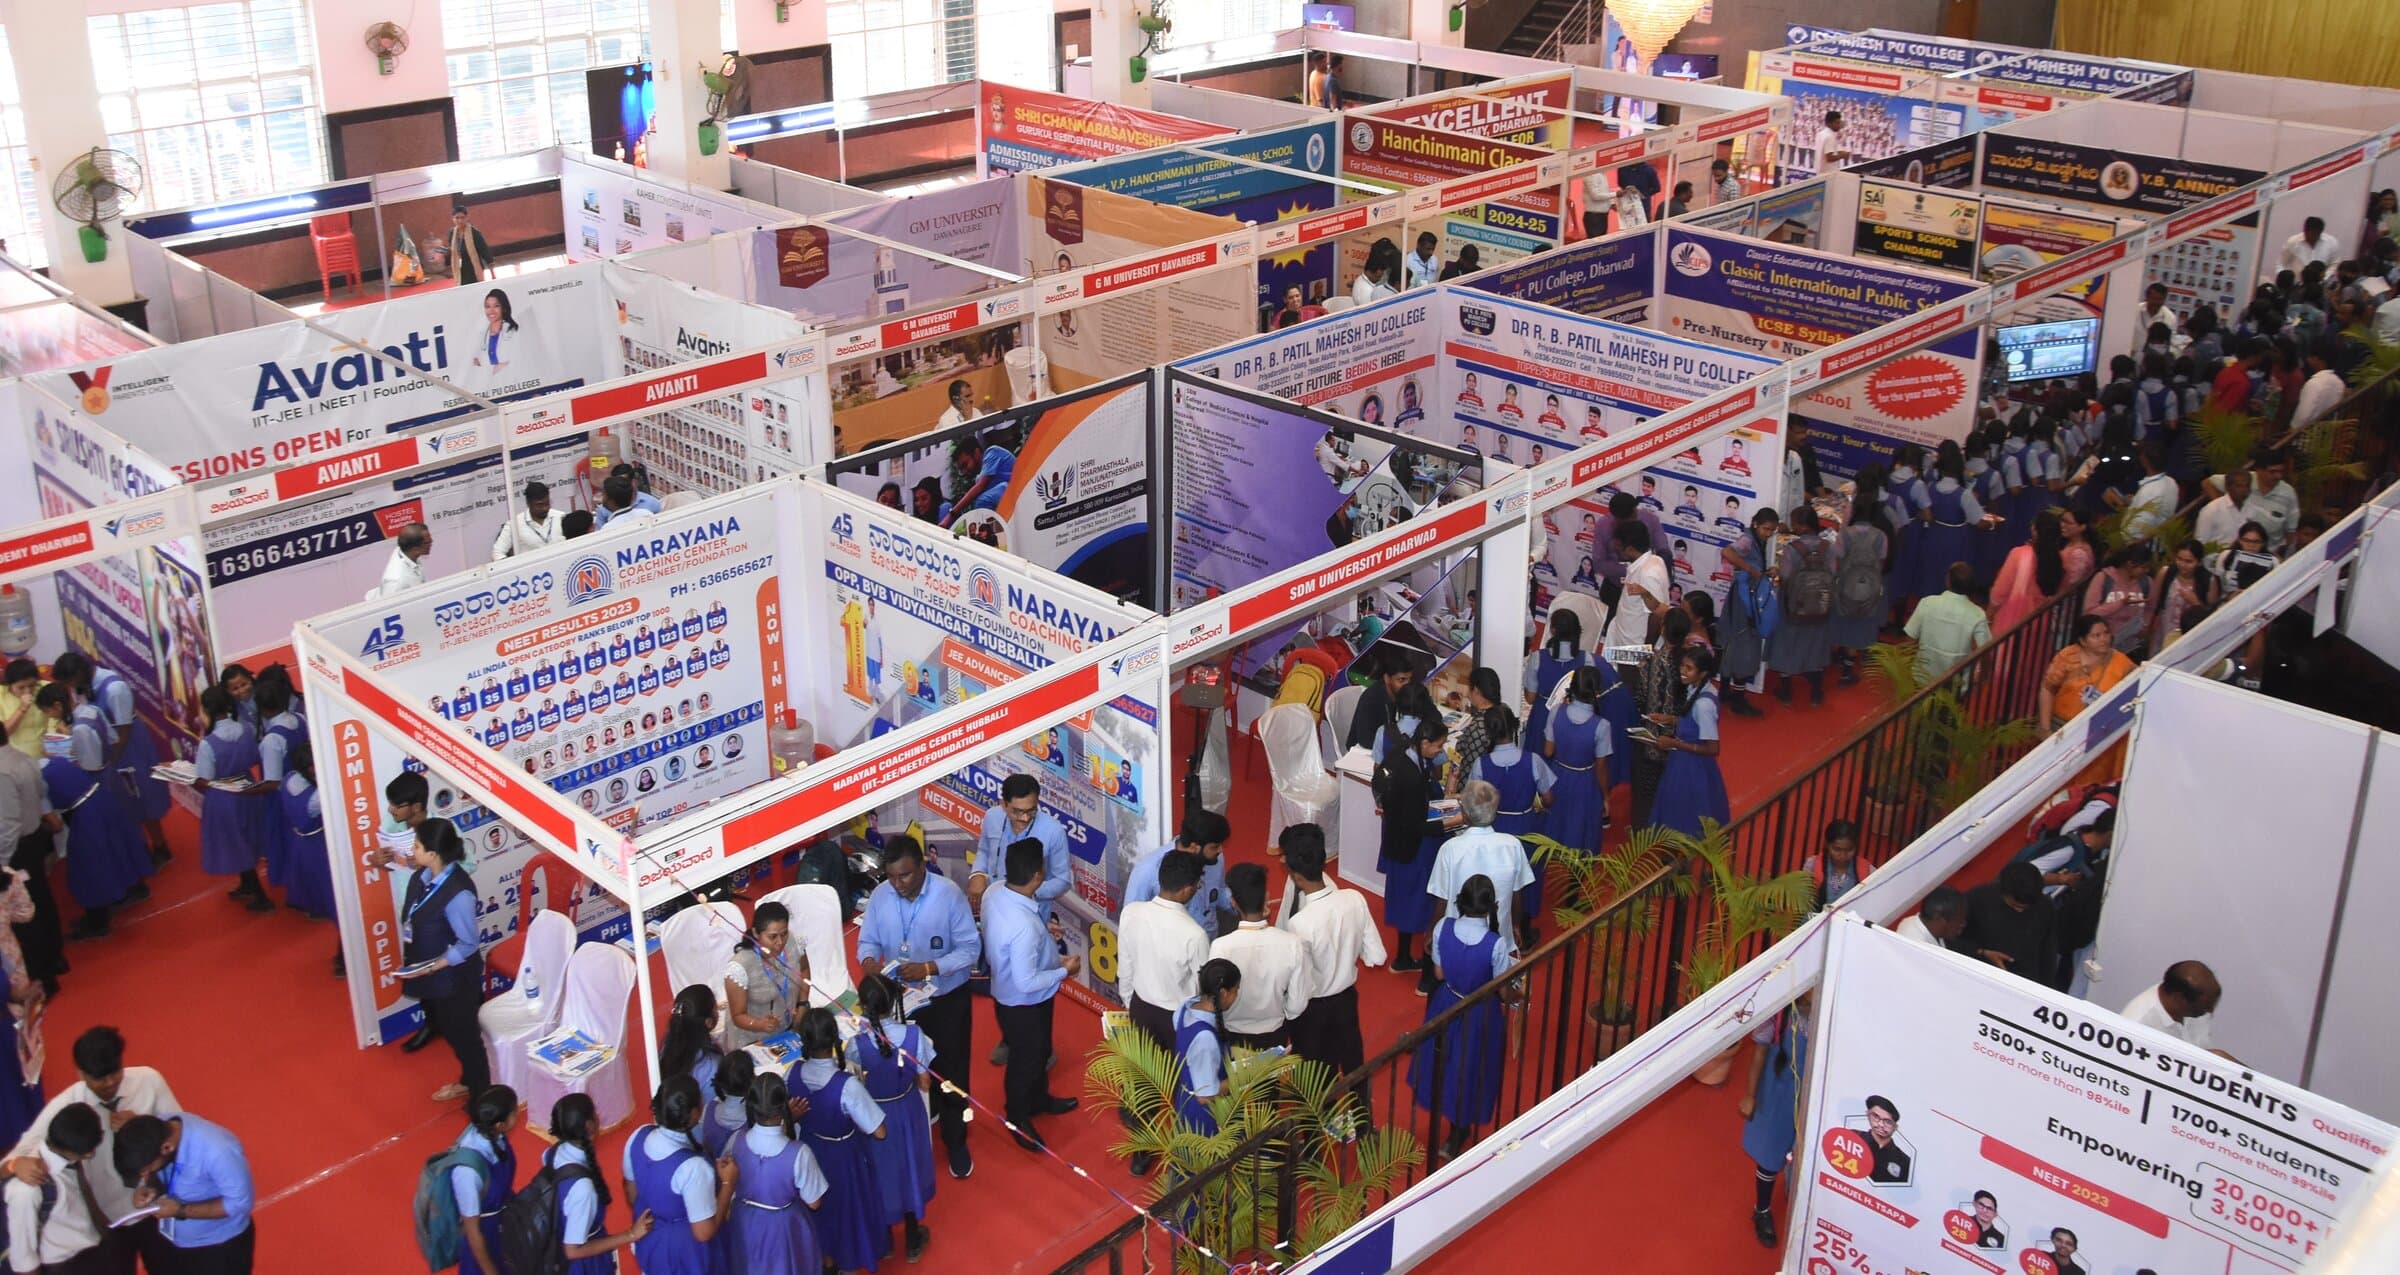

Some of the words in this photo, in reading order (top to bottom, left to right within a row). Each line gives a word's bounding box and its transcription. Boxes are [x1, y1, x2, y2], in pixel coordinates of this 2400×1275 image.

[1015, 108, 1041, 124] SHRI
[990, 143, 1053, 167] ADMISSIONS
[1130, 165, 1193, 187] HANCHINMANI
[1263, 145, 1294, 161] SCHOOL
[1382, 128, 1486, 166] Hanchinmani
[908, 219, 931, 234] GM
[931, 203, 1003, 229] UNIVERSITY
[1489, 209, 1547, 233] 2024-25
[1874, 225, 1913, 240] SPORTS
[1917, 232, 1959, 249] SCHOOL
[1095, 278, 1103, 290] G
[1103, 276, 1112, 288] M
[1113, 263, 1162, 285] UNIVERSITY
[1162, 251, 1207, 272] DAVANGERE
[1590, 253, 1635, 278] Dharwad
[1720, 259, 1765, 282] Classic
[1770, 270, 1862, 302] International
[1866, 287, 1911, 311] Public
[528, 279, 583, 297] www.avanti.in
[911, 323, 951, 340] DAVANGERE
[1234, 359, 1250, 379] DR
[1254, 356, 1266, 373] R.
[1269, 351, 1279, 368] B.
[1283, 342, 1312, 364] PATIL
[1315, 328, 1362, 354] MAHESH
[1364, 321, 1379, 339] PU
[1381, 306, 1426, 334] COLLEGE
[1511, 319, 1529, 334] DR
[1533, 324, 1546, 340] R.
[1551, 328, 1562, 345] B.
[1568, 332, 1604, 354] PATIL
[1609, 341, 1668, 369] MAHESH
[1674, 356, 1694, 375] PU
[1682, 318, 1768, 352] Pre-Nursery
[1758, 317, 1794, 335] ICSE
[252, 324, 449, 412] Avanti
[788, 352, 815, 369] EXPO
[1306, 371, 1342, 392] FUTURE
[1345, 359, 1378, 379] BEGINS
[1380, 350, 1405, 368] HERE!
[645, 374, 699, 402] AVANTI
[252, 407, 303, 428] IIT-JEE
[320, 394, 356, 412] NEET
[273, 427, 342, 462] OPEN
[347, 428, 373, 444] For
[446, 435, 477, 449] EXPO
[317, 452, 382, 486] AVANTI
[1080, 459, 1095, 470] SHRI
[1080, 457, 1129, 479] DHARMASTHALA
[1080, 460, 1144, 487] MANJUNATHESHWARA
[1080, 480, 1115, 497] UNIVERSITY
[126, 516, 165, 533] EXPO
[384, 508, 417, 520] HOSTEL
[221, 520, 368, 577] 6366437712
[616, 516, 740, 568] NARAYANA
[619, 551, 681, 579] COACHING
[684, 537, 728, 560] CENTER
[868, 523, 961, 582] ನಾರಾಯಣ
[619, 542, 748, 590] IIT-JEE/NEET/FOUNDATION
[670, 585, 688, 598] PH
[700, 555, 774, 589] 6366565627
[1289, 573, 1316, 601] SDM
[1318, 549, 1384, 588] UNIVERSITY
[1385, 526, 1438, 559] DHARWAD
[434, 571, 554, 627] ನಾರಾಯಣ
[862, 574, 889, 601] BVB
[891, 585, 974, 640] VIDYANAGAR,
[913, 585, 1045, 654] IIT-JEE/NEET/FOUNDATION
[360, 614, 405, 661] 45
[440, 607, 551, 650] IIT-JEE/NEET/FOUNDATION
[467, 669, 482, 681] ALL
[483, 661, 507, 675] INDIA
[508, 653, 529, 665] OPEN
[531, 636, 577, 660] CATEGORY
[578, 626, 605, 643] RANKS
[607, 616, 634, 632] BELOW
[636, 612, 651, 622] TOP
[652, 606, 670, 617] 1000
[504, 633, 538, 652] NEET
[542, 614, 599, 642] RESULTS
[601, 603, 633, 622] 2023
[766, 604, 779, 645] NOW
[1009, 610, 1082, 654] COACHING
[386, 642, 420, 659] YEARS
[458, 702, 472, 714] 31
[485, 692, 499, 705] 35
[512, 683, 526, 696] 51
[538, 675, 553, 687] 52
[562, 666, 577, 678] 62
[589, 657, 602, 669] 69
[613, 648, 627, 660] 88
[638, 640, 652, 652] 89
[660, 631, 677, 643] 123
[684, 623, 701, 635] 128
[708, 614, 725, 627] 150
[947, 649, 964, 663] JEE
[1127, 651, 1160, 670] EXPO
[771, 661, 783, 688] IN
[488, 732, 506, 744] 219
[514, 722, 533, 735] 225
[615, 686, 634, 698] 284
[639, 678, 657, 690] 301
[664, 669, 682, 681] 303
[689, 660, 706, 674] 315
[710, 651, 729, 664] 339
[832, 766, 878, 793] NARAYAN
[878, 744, 928, 771] COACHING
[928, 727, 965, 750] CENTRE
[965, 707, 1009, 734] HUBBALLI
[861, 730, 985, 795] (IIT-JEE/NEET/FOUNDATION)
[924, 789, 954, 812] NEET
[639, 846, 713, 888] ವಿಜಯವಾಣಿ
[372, 920, 395, 989] OPEN
[601, 927, 620, 940] PH
[1972, 1041, 2015, 1067] Scored
[2017, 1061, 2051, 1081] more
[2053, 1073, 2083, 1096] than
[2086, 1089, 2131, 1115] 98%ile
[1977, 1023, 2037, 1057] 3500+
[2041, 1050, 2131, 1096] Students
[1830, 1150, 1859, 1175] 24
[1833, 1135, 1864, 1159] AIR
[2046, 1117, 2204, 1199] Empowering
[2170, 1124, 2215, 1152] Scored
[2217, 1143, 2253, 1164] more
[2255, 1158, 2288, 1182] than
[2171, 1105, 2231, 1139] 1700+
[2236, 1132, 2341, 1187] Students
[1826, 1177, 1863, 1203] SAMUEL
[1863, 1195, 1875, 1208] H.
[1876, 1202, 1906, 1224] TSAPA
[2032, 1165, 2070, 1190] NEET
[2072, 1184, 2110, 1208] 2023
[2213, 1177, 2318, 1233] 20,000+
[1951, 1215, 1973, 1231] AIR
[1951, 1226, 1968, 1239] 28
[2211, 1198, 2297, 1247] 3,500+
[1813, 1231, 1870, 1274] 25%
[2027, 1253, 2051, 1270] AIR
